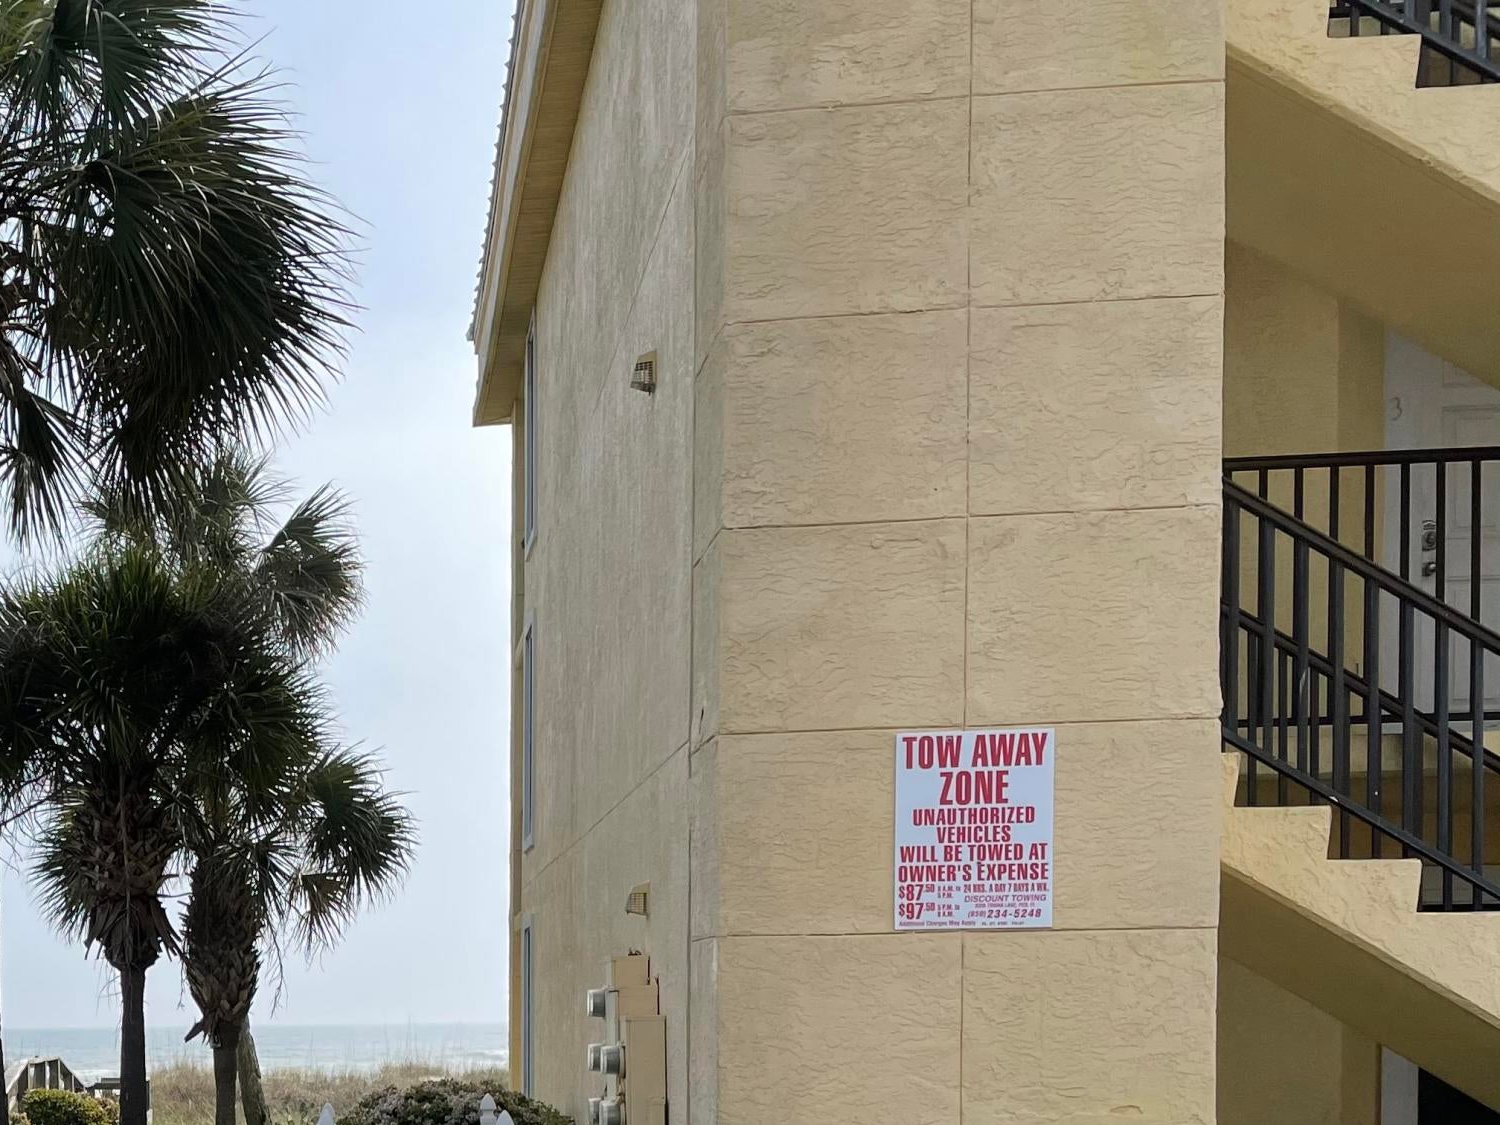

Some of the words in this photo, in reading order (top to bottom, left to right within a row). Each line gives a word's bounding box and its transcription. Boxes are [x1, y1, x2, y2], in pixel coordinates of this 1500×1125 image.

[1389, 396, 1403, 421] 3
[902, 735, 963, 769] TOW
[971, 733, 1048, 767] AWAY
[939, 770, 1009, 805] ZONE
[912, 806, 1035, 826] UNAUTHORIZED
[937, 825, 1011, 843] VEHICLES
[900, 846, 938, 863] WILL
[944, 845, 962, 862] BE
[967, 843, 1023, 862] TOWED
[1029, 843, 1048, 860] AT
[898, 864, 971, 882] OWNER'S
[977, 863, 1048, 881] EXPENSE
[963, 884, 971, 893] 24
[989, 884, 993, 893] A
[994, 883, 1006, 892] DAY
[1008, 883, 1012, 892] 7
[1013, 883, 1029, 892] DAYS
[1030, 883, 1035, 892] A
[964, 894, 1009, 903] DISCOUNT
[1012, 894, 1047, 902] TOWING
